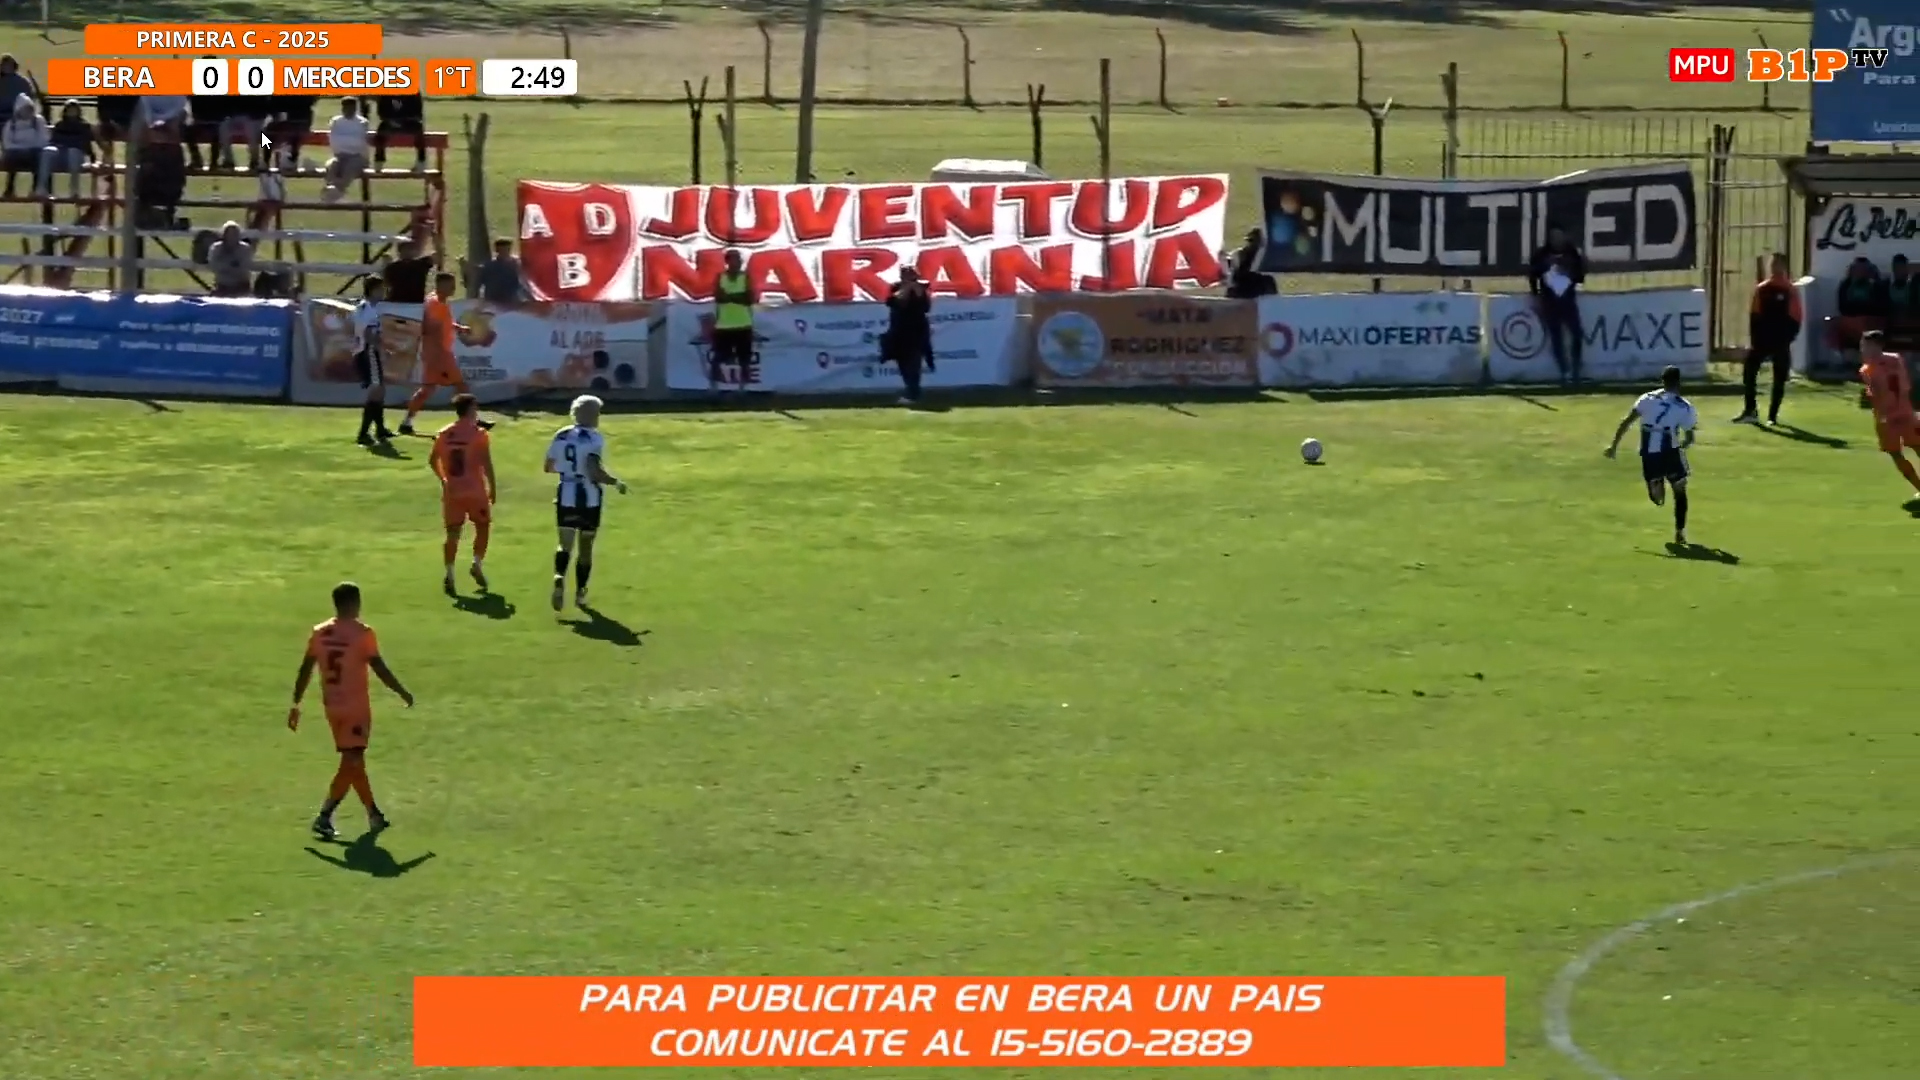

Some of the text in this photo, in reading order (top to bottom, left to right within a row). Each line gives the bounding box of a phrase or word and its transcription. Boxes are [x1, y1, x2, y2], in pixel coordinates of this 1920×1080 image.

[1863, 71, 1917, 85] Para
[520, 202, 617, 240] A D
[639, 176, 1226, 247] JUVENTUD
[556, 252, 592, 290] B
[639, 230, 1224, 303] NARANJA
[1658, 402, 1671, 424] 7
[564, 443, 578, 473] 9
[326, 650, 345, 685] 5
